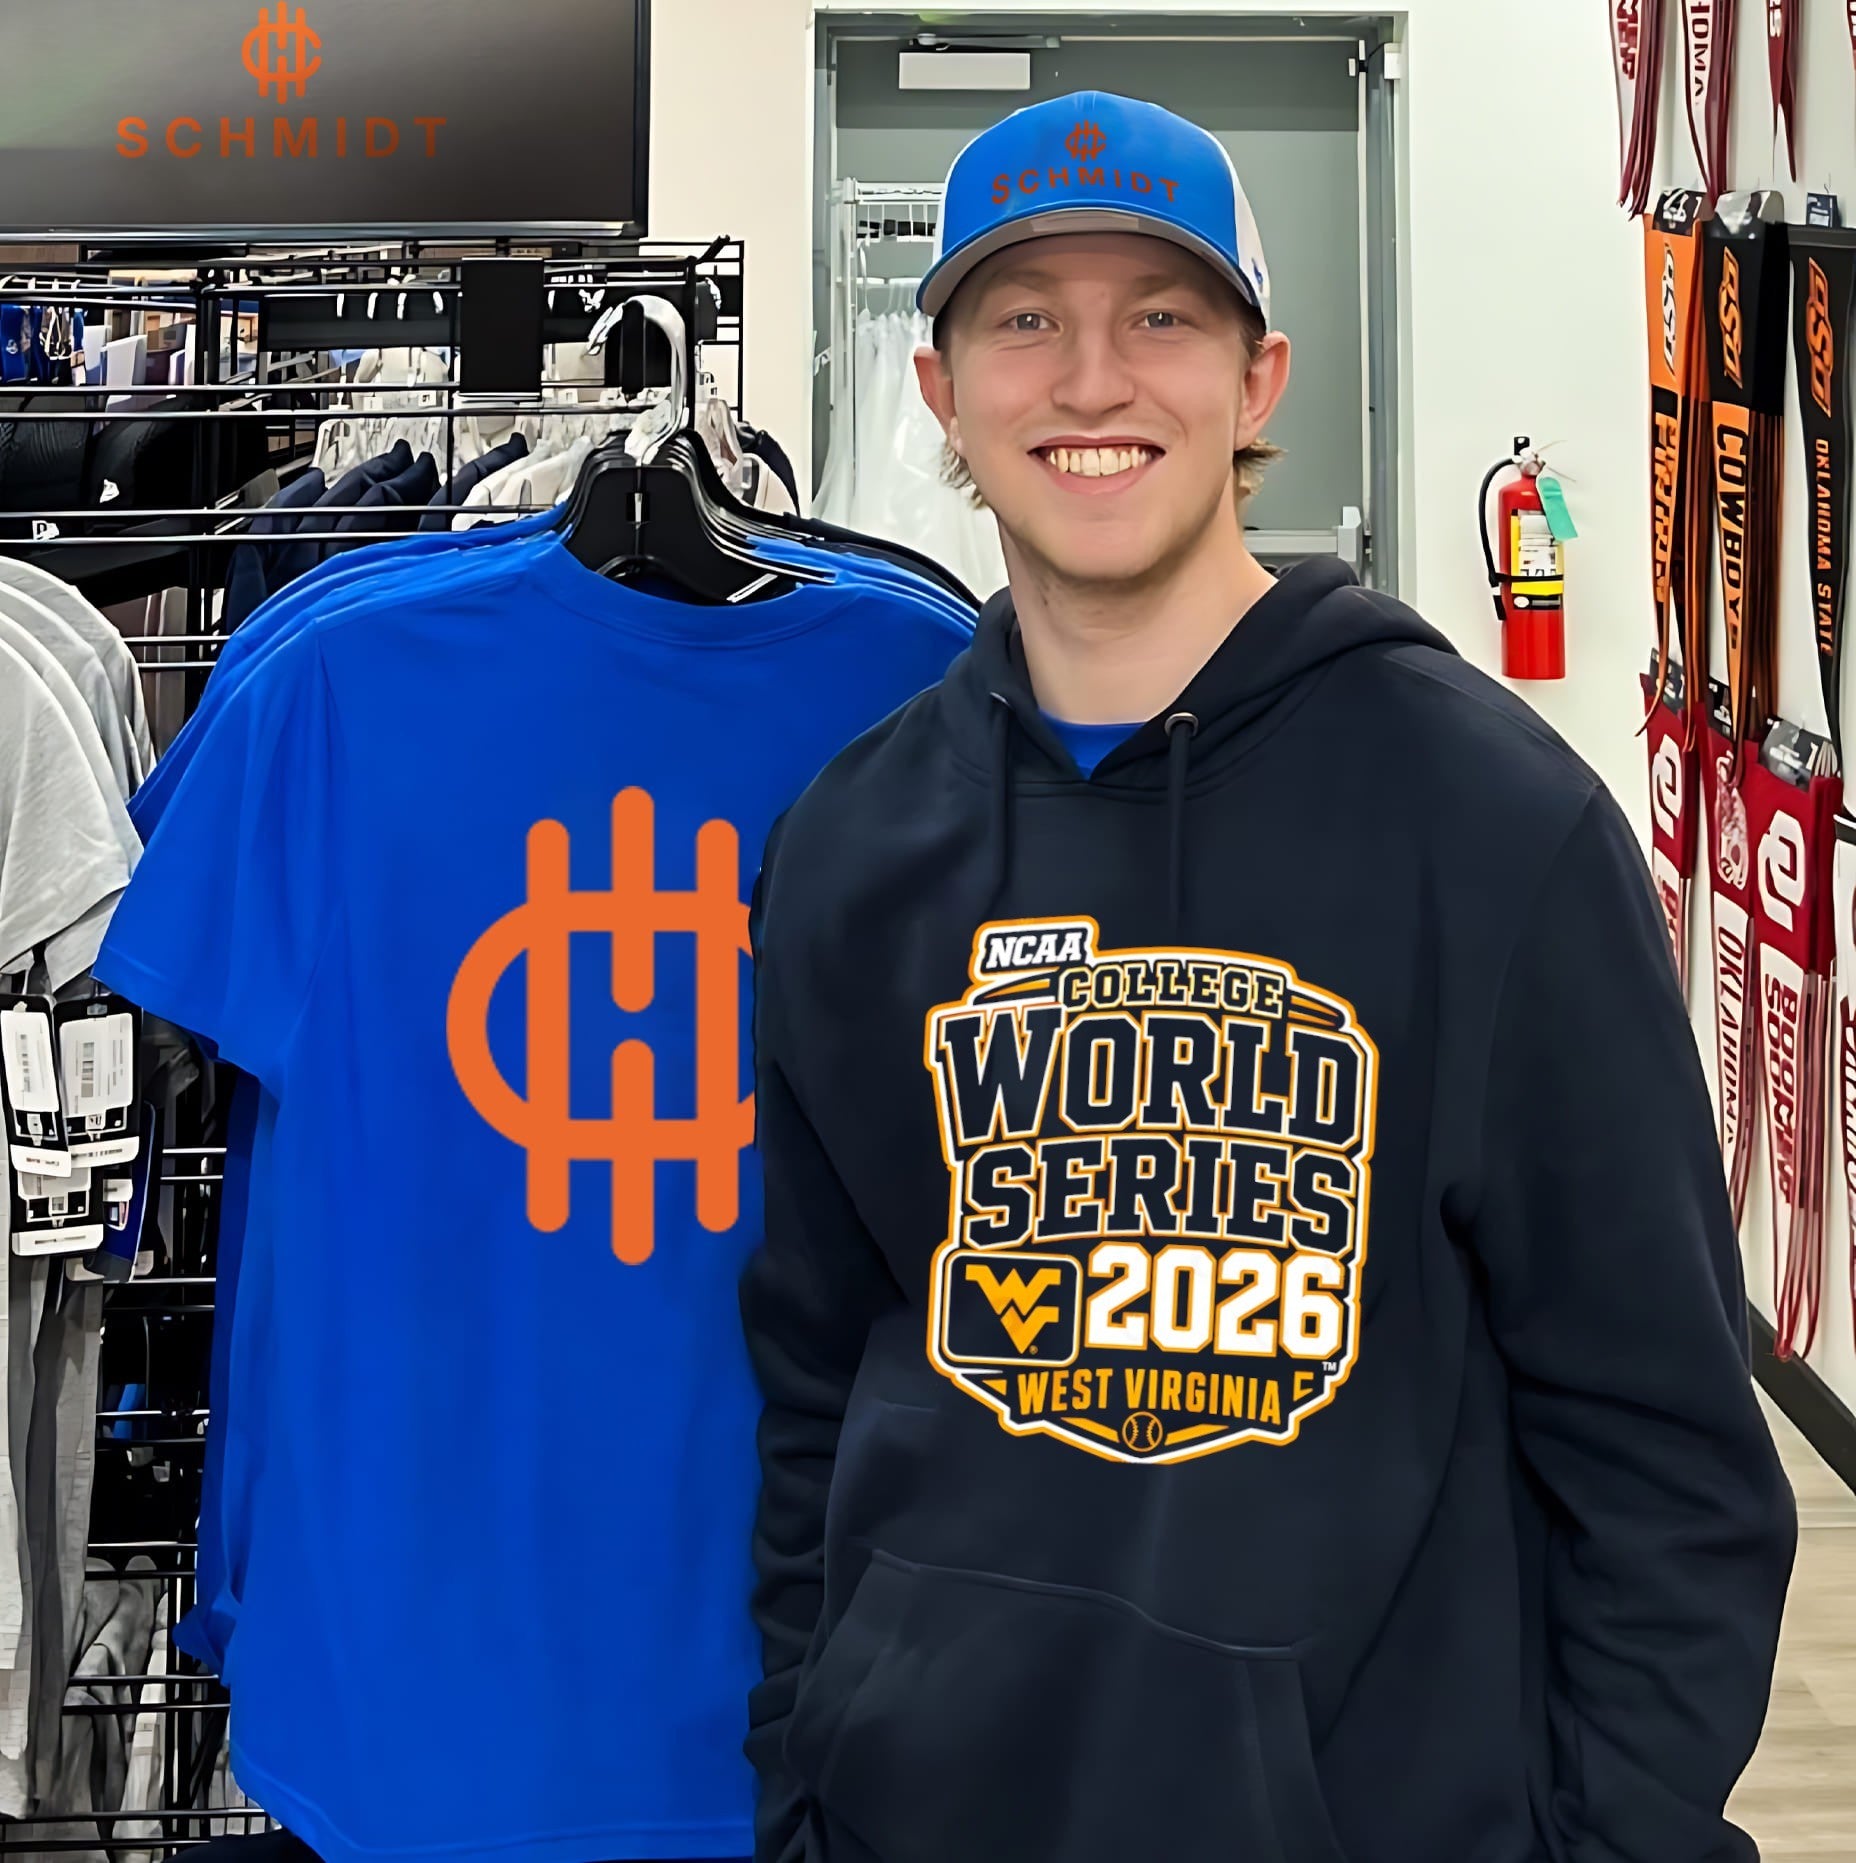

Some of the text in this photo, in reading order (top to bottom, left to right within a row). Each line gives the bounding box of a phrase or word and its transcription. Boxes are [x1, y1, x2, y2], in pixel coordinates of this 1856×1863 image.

[115, 116, 448, 158] SCHMIDT
[991, 166, 1180, 205] SCHMIDT
[1815, 438, 1833, 657] OKLAHOMA STATE
[985, 931, 1083, 969] NCAA
[1059, 961, 1286, 1019] COLLEGE
[938, 1004, 1366, 1150] WORLD
[1718, 926, 1745, 1144] OKLAHOMA
[963, 1132, 1357, 1257] SERIES
[1085, 1241, 1345, 1359] 2026
[1017, 1367, 1282, 1426] WEST VIRGINIA
